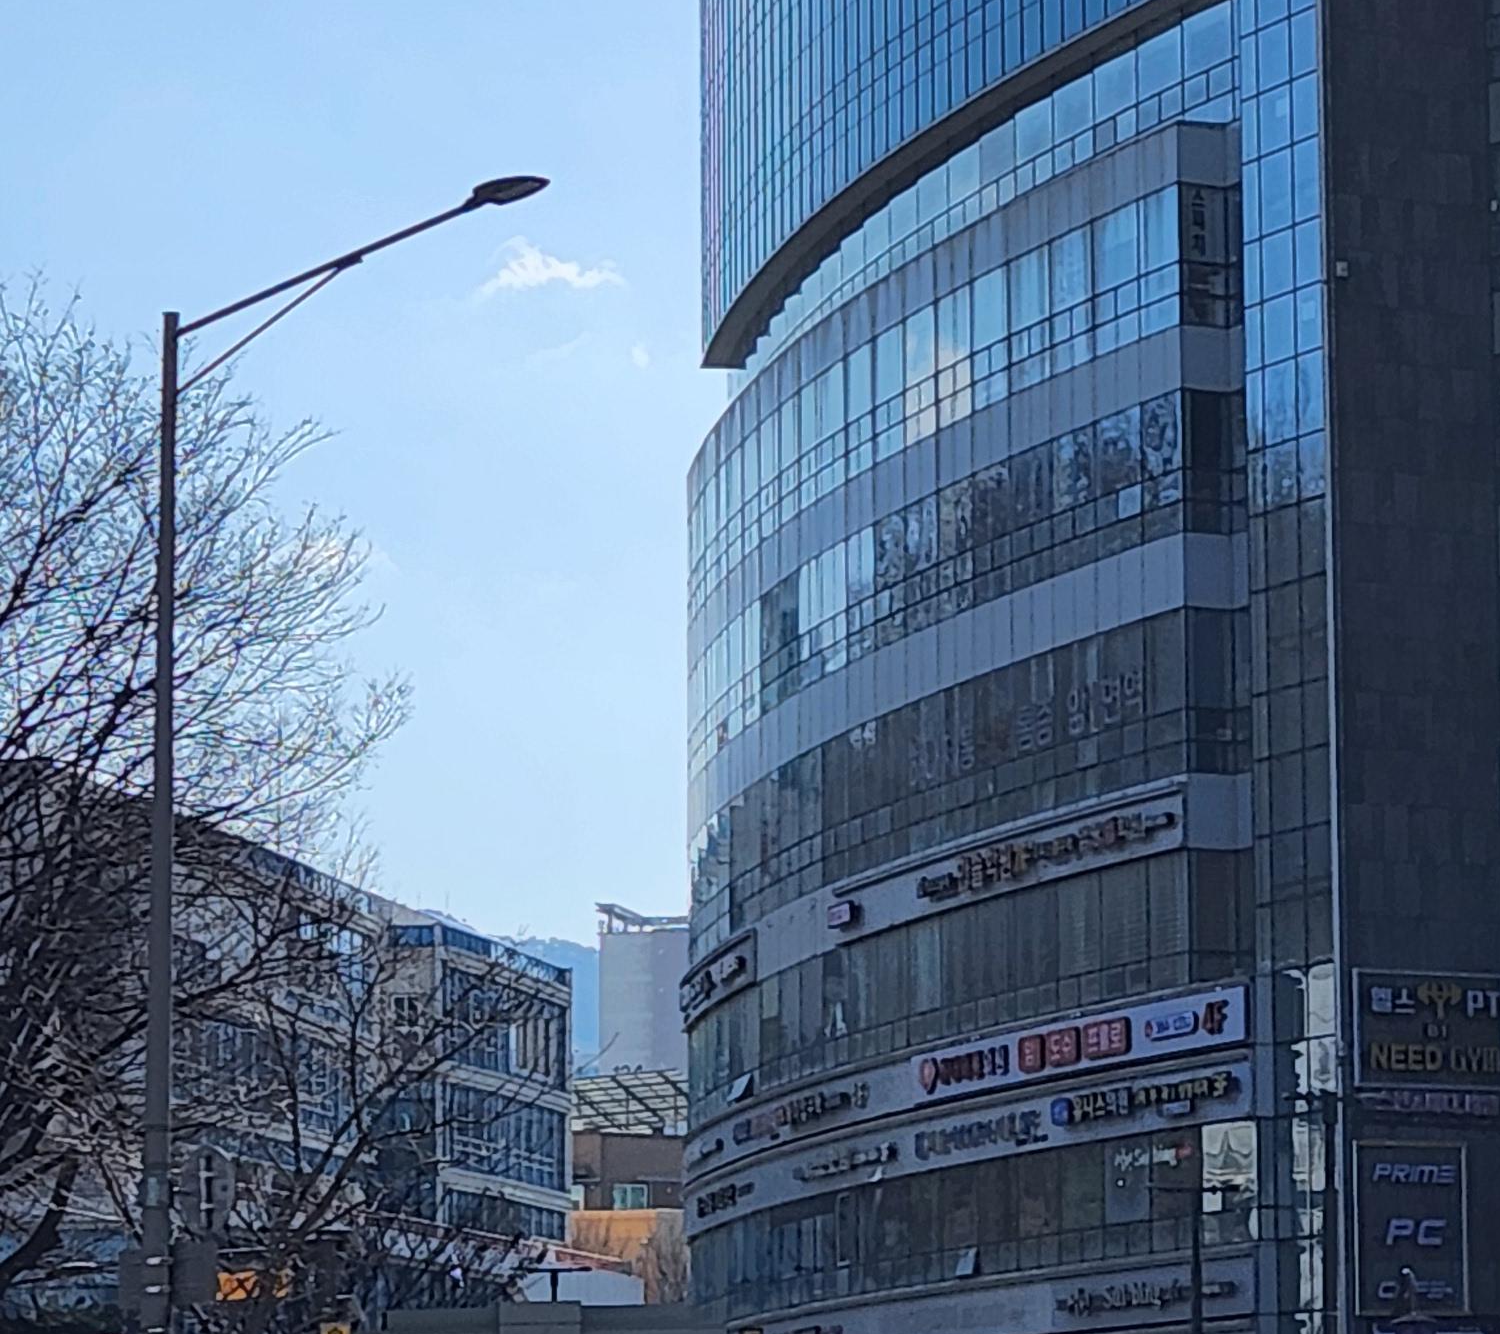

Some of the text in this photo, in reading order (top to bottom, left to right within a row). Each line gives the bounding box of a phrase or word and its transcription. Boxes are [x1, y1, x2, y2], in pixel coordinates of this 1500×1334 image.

[1370, 1042, 1500, 1073] NEED GYM
[1372, 1162, 1457, 1185] PRIME
[1385, 1218, 1447, 1247] PC
